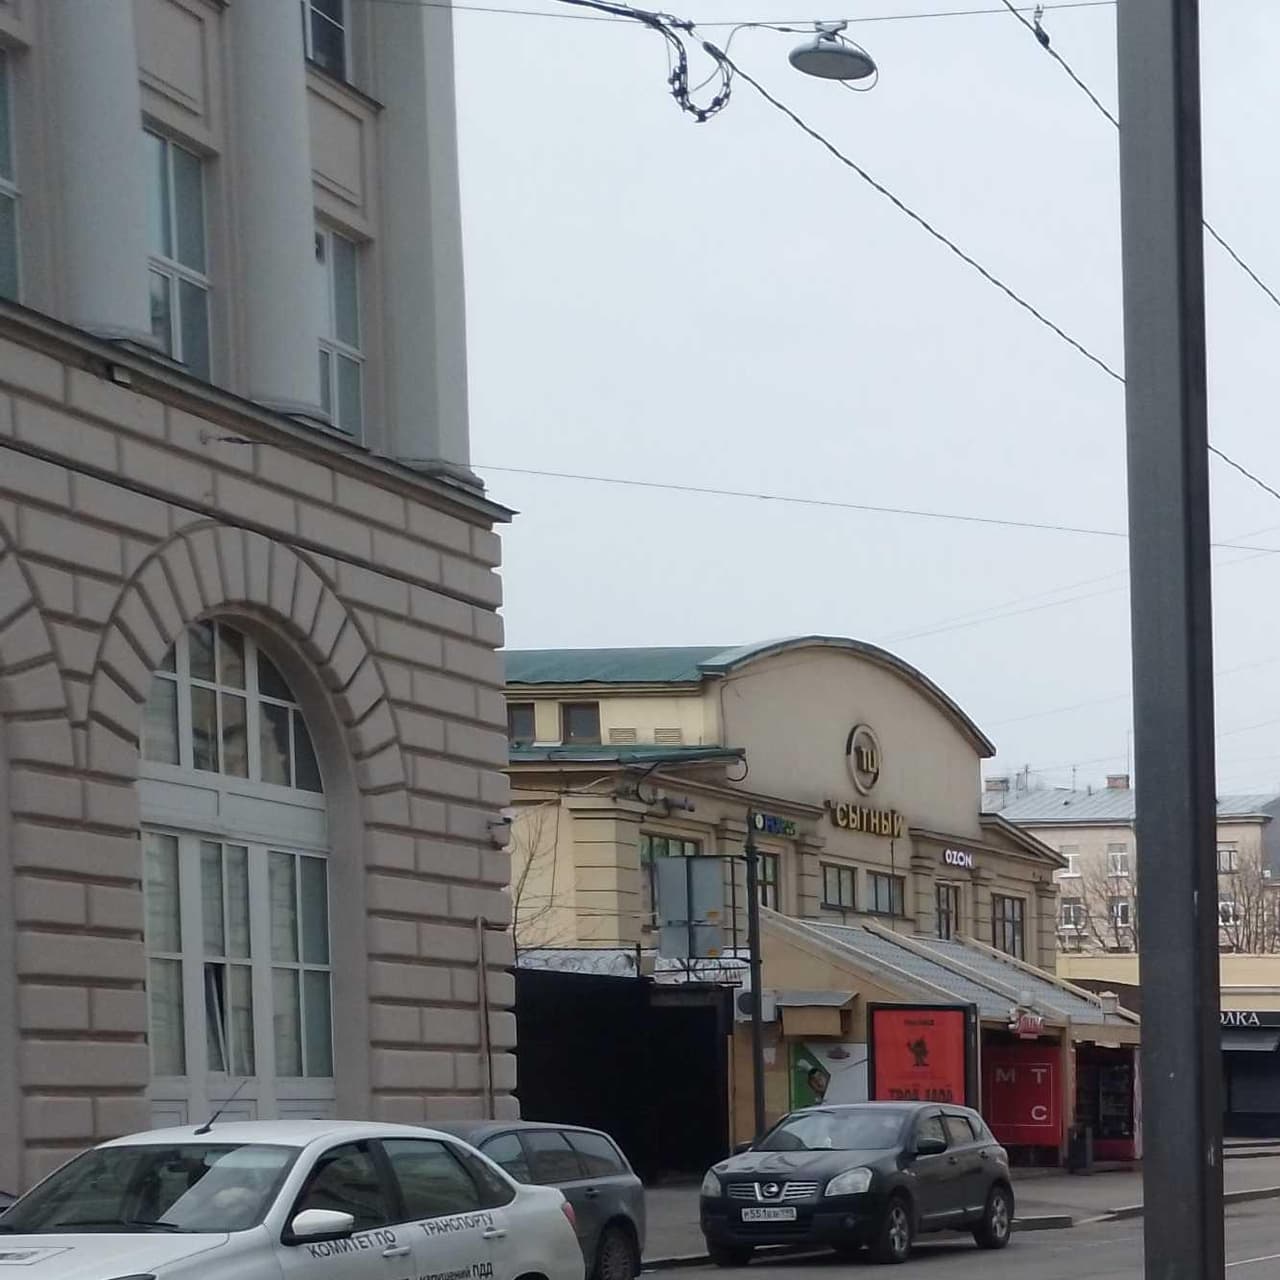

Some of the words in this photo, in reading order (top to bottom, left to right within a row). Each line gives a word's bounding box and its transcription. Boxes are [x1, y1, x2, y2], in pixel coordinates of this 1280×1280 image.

[945, 849, 972, 866] OZON
[307, 1233, 375, 1258] КОМИТЕТ
[375, 1230, 396, 1245] ПО
[419, 1213, 494, 1236] ТРАНСПОРТУ
[472, 1262, 493, 1279] ПДД
